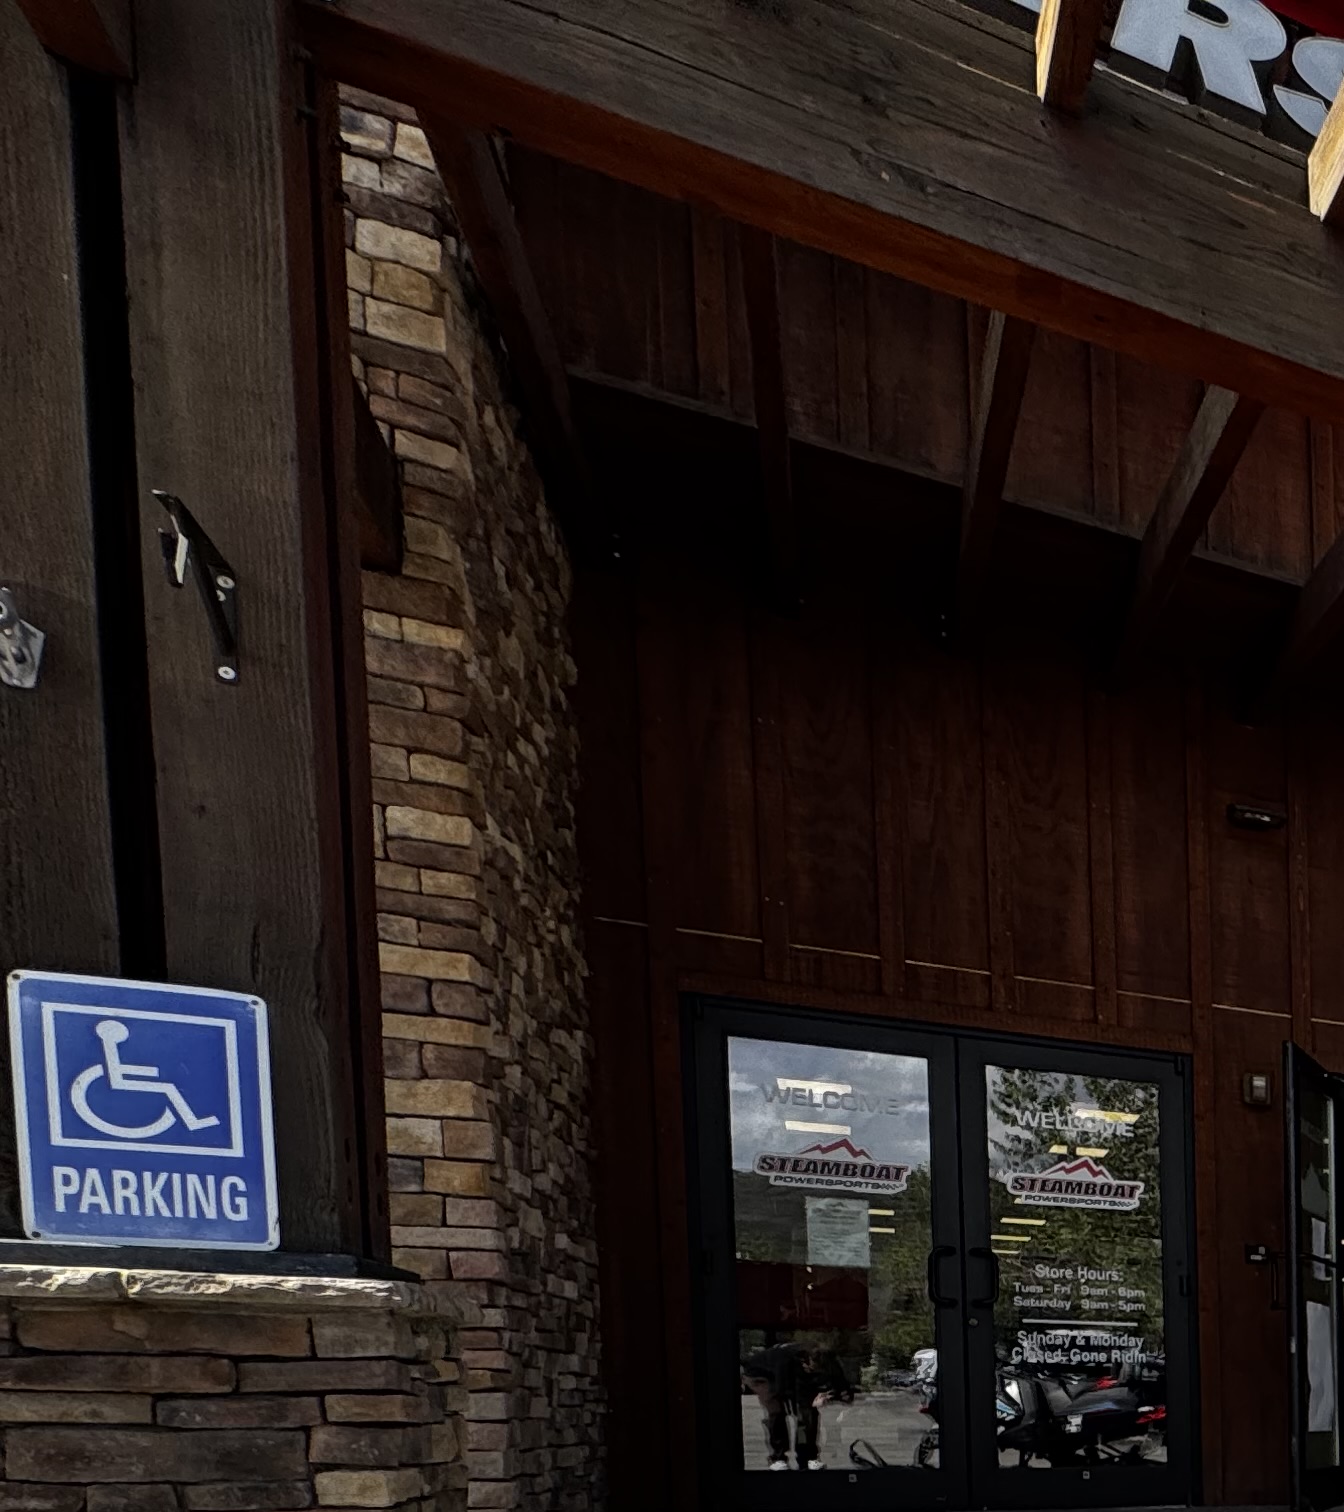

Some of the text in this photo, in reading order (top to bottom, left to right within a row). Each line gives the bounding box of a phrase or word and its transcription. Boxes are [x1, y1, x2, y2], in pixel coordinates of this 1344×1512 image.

[759, 1083, 900, 1116] WELCOME
[1014, 1108, 1135, 1137] WELCOME
[758, 1154, 909, 1182] STEAMBOAT
[774, 1175, 880, 1189] POWERSPORTS
[1011, 1176, 1143, 1200] STEAMBOAT
[52, 1165, 249, 1222] PARKING
[1024, 1195, 1118, 1207] POWERSPORTS
[1034, 1263, 1124, 1282] Store Hours:
[1013, 1296, 1072, 1311] Saturday
[1017, 1331, 1072, 1349] Sunday
[1089, 1333, 1145, 1350] Monday
[1070, 1349, 1108, 1364] Gone
